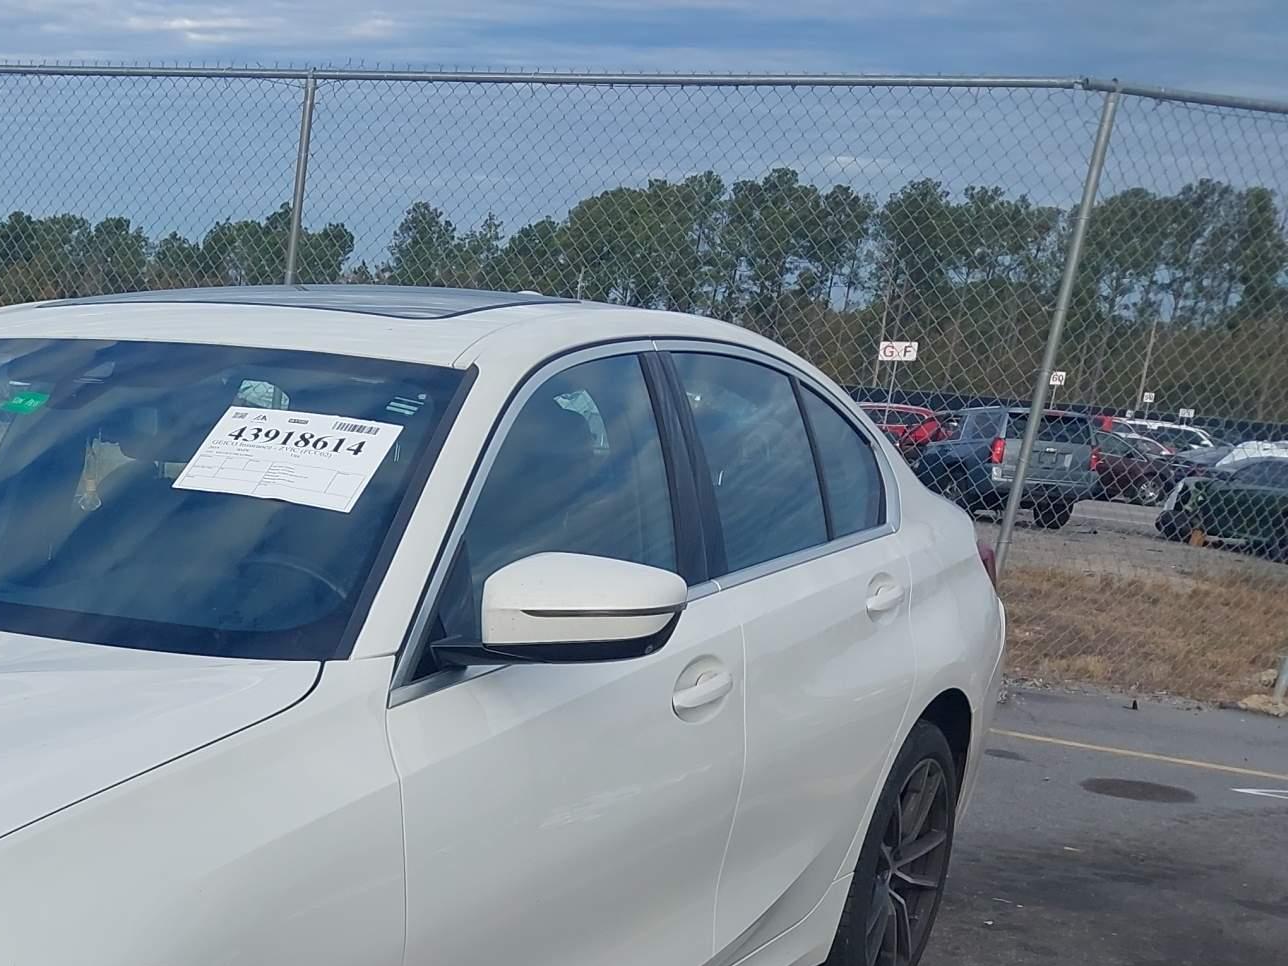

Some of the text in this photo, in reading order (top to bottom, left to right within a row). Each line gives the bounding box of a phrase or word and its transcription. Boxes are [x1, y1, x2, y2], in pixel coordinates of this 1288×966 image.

[883, 345, 913, 357] G F
[1051, 374, 1064, 383] 60
[227, 425, 367, 456] 43918614
